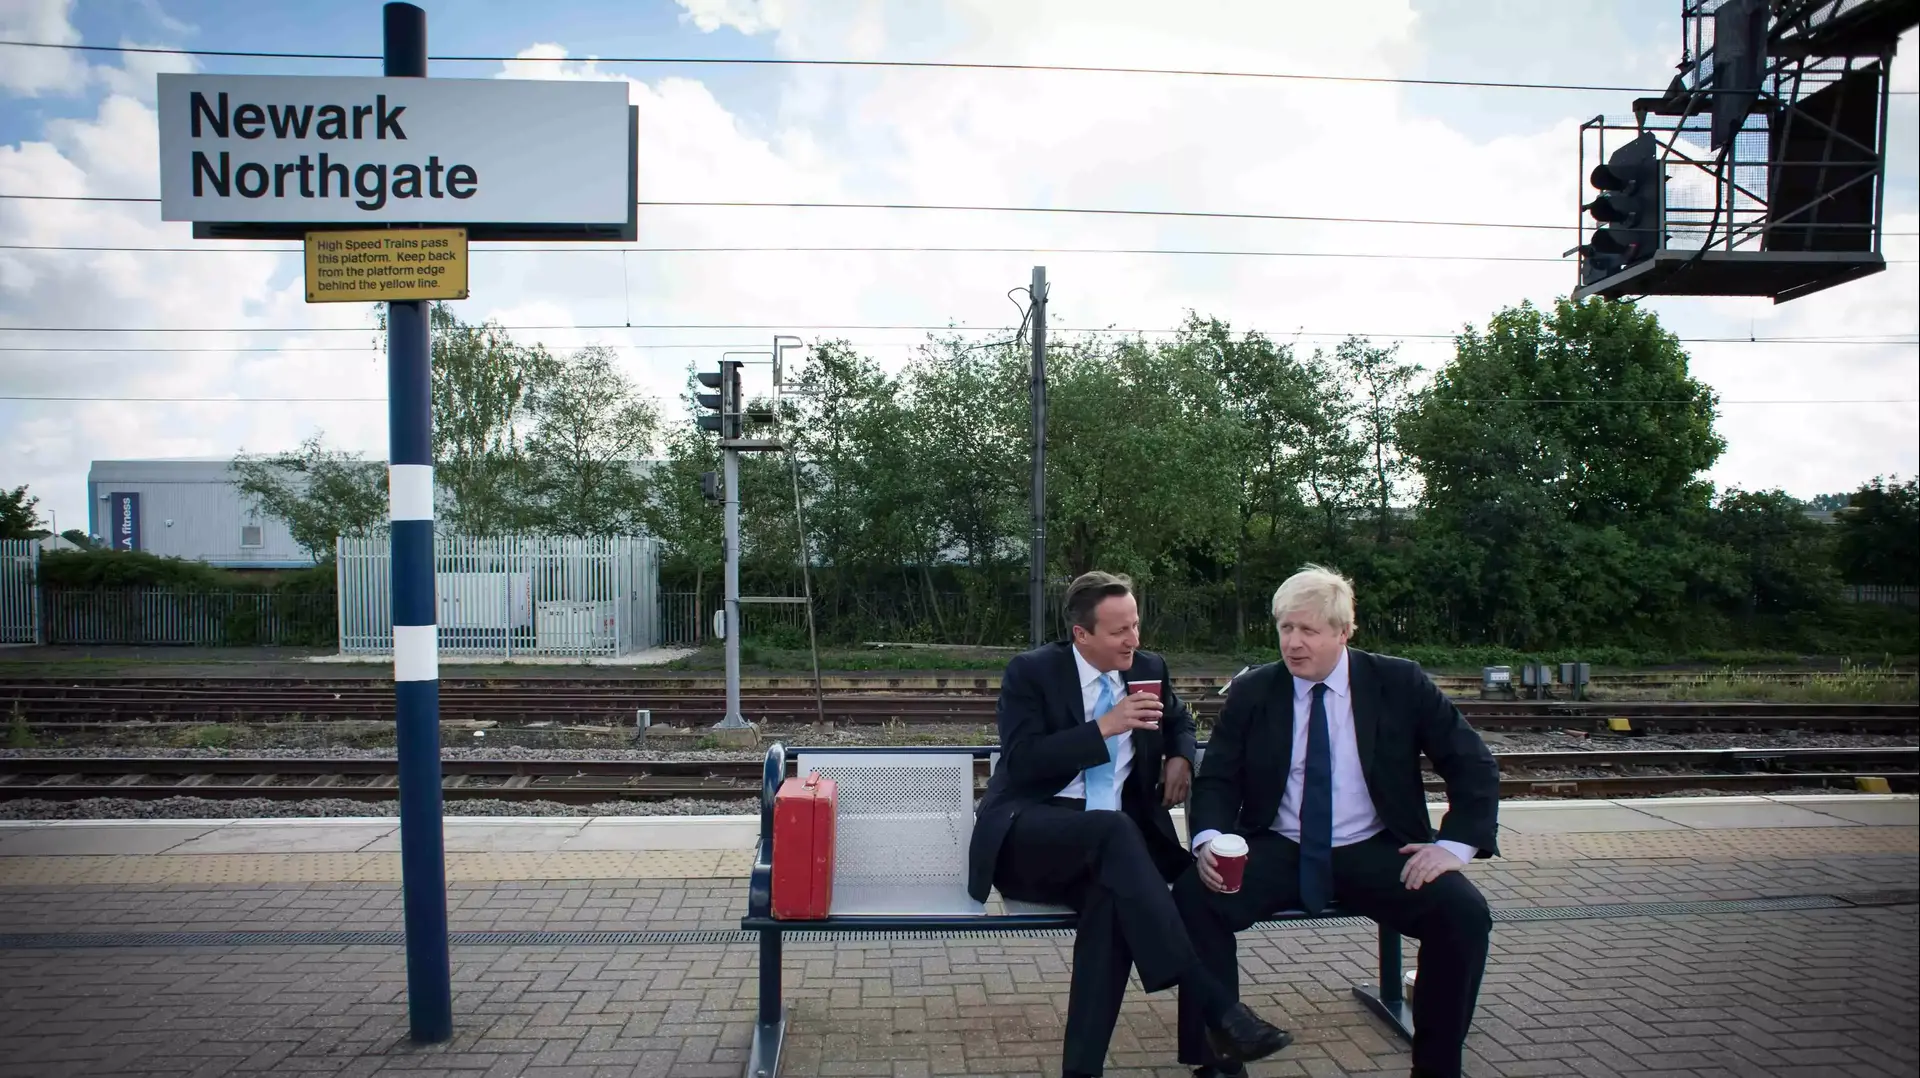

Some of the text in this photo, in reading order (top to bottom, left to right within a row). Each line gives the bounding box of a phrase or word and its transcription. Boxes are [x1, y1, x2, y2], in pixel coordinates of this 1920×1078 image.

[190, 91, 407, 140] Newark
[192, 151, 478, 211] Northgate
[318, 238, 449, 252] High Speed Trains pass
[318, 250, 456, 266] this platform. Keep back
[318, 264, 445, 278] from the platform edge
[318, 278, 441, 292] behind the yellow line.
[122, 498, 131, 535] fitness
